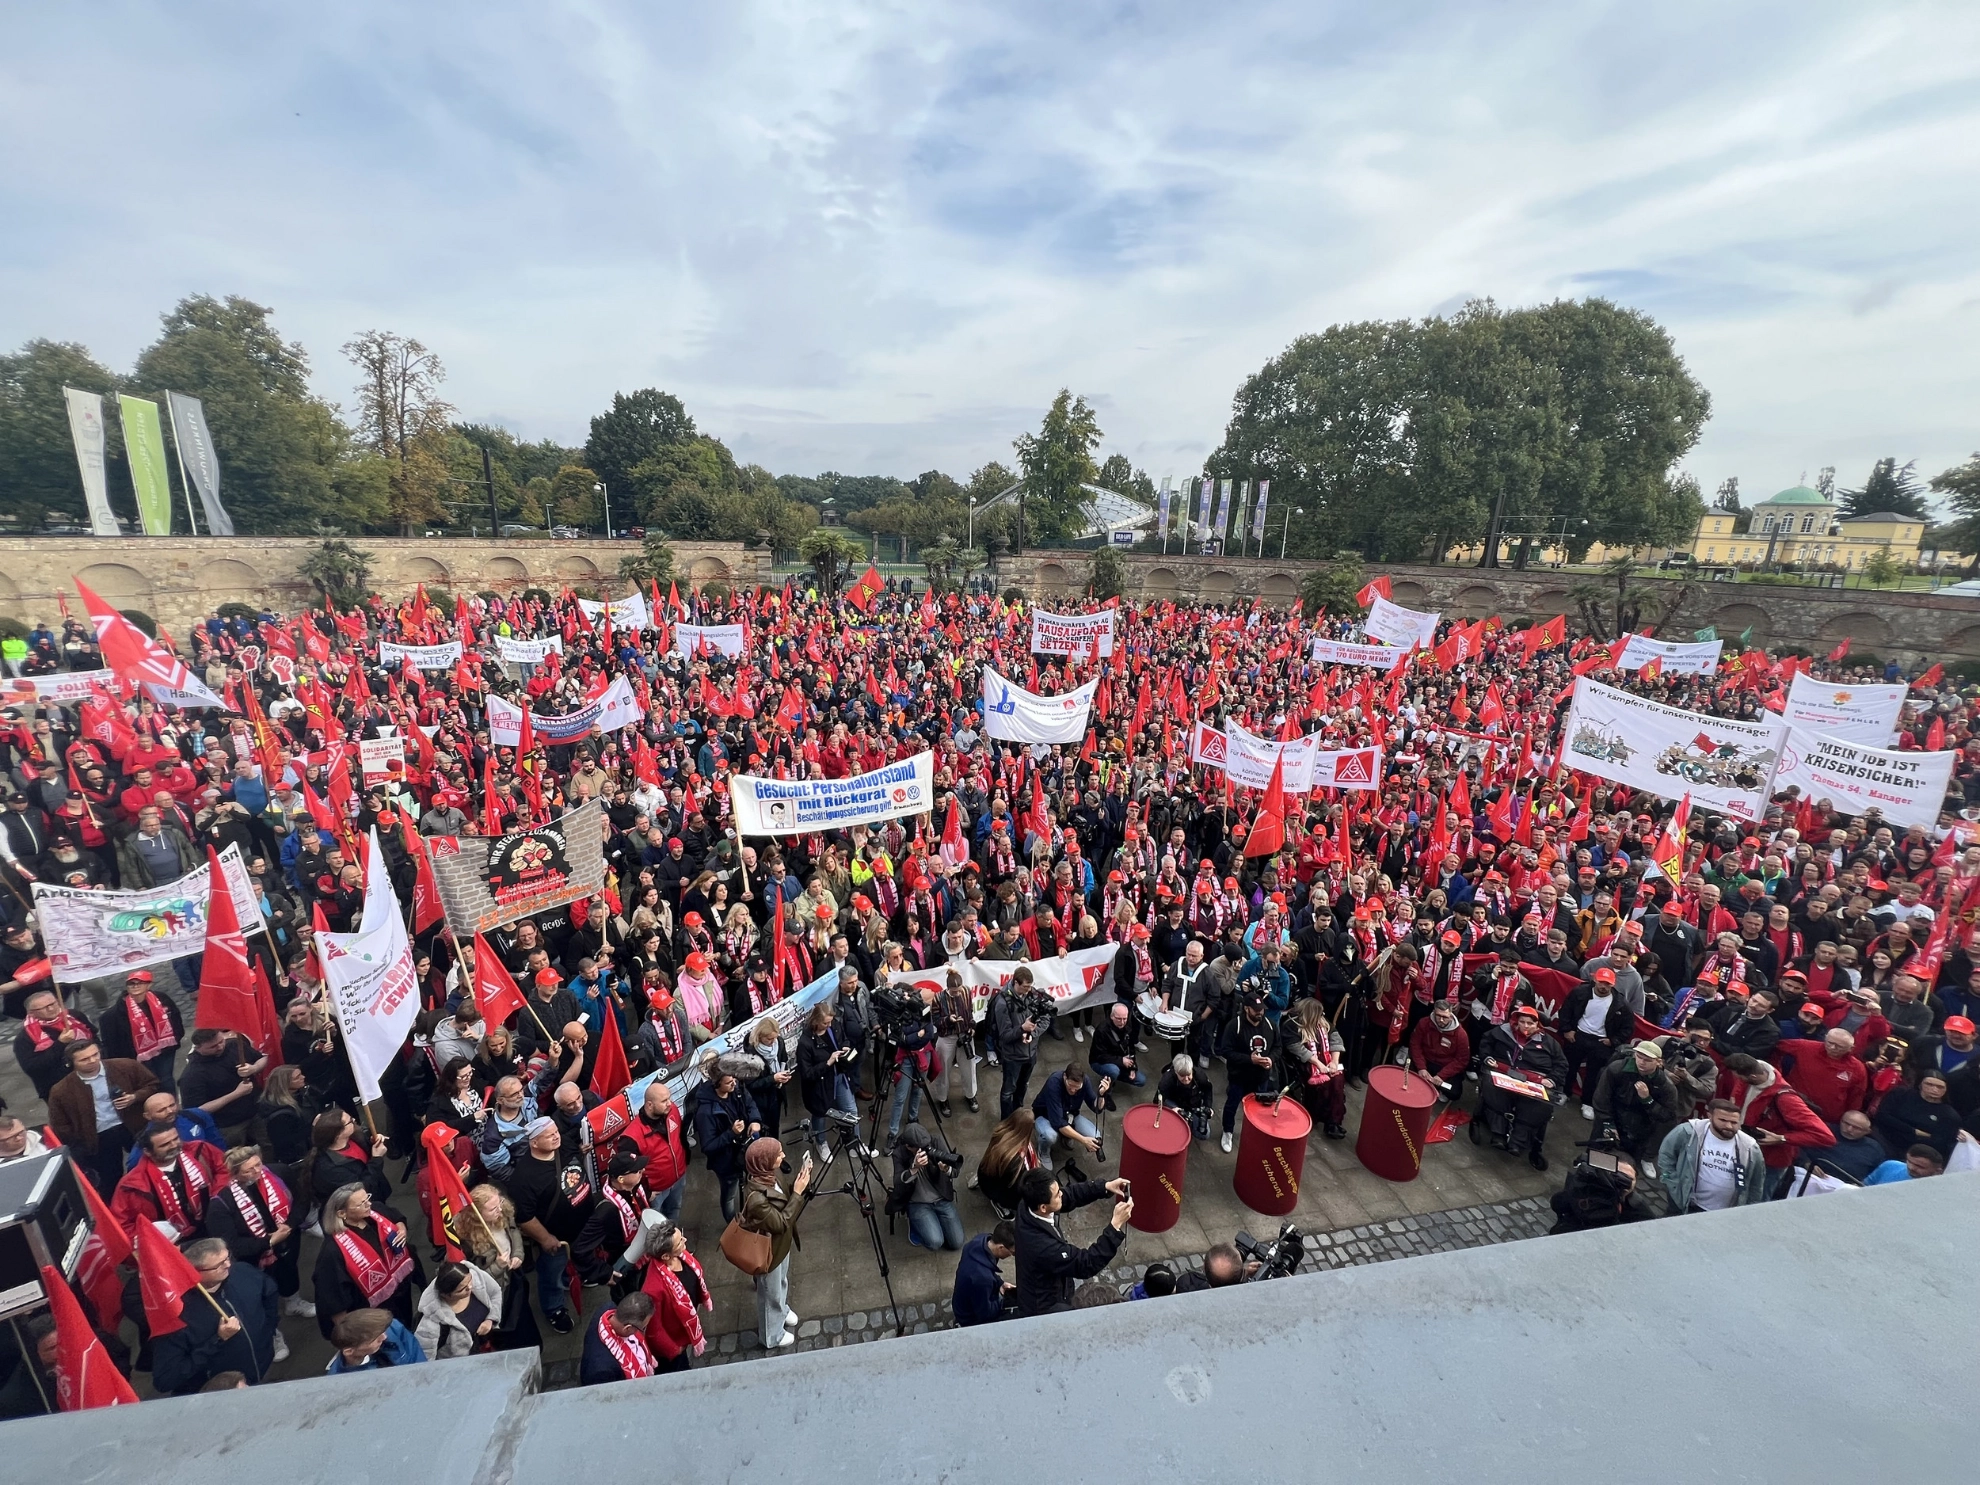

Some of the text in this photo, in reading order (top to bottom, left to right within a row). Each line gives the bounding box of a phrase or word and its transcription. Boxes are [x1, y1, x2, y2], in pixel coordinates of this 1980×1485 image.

[1038, 618, 1059, 626] THOMAS
[1038, 624, 1110, 638] HAUSAUFGABE
[382, 644, 396, 652] Wo
[1040, 640, 1080, 652] SETZEN!
[1348, 652, 1367, 660] EURO
[1368, 655, 1392, 664] MEHR!
[532, 704, 602, 726] VERTRAUENSLEUTE
[1588, 686, 1770, 738] Wir kämpfen für unsere Tarifverträge!
[363, 744, 402, 754] SOLIDARITÄT
[1860, 754, 1888, 768] JOB
[1892, 760, 1921, 772] IST
[754, 761, 917, 800] Gesucht: Personalvorstand
[1242, 768, 1264, 778] können
[1242, 776, 1266, 785] endlich
[1811, 773, 1845, 790] Thomas
[1868, 788, 1913, 806] Manager
[798, 788, 888, 811] mit Rückgrat
[796, 804, 880, 823] Beschäftigungssicherung
[489, 848, 500, 866] WIR
[530, 829, 566, 851] ZUSAMMEN
[1714, 1158, 1728, 1166] FOR
[1262, 1158, 1285, 1200] sicherung
